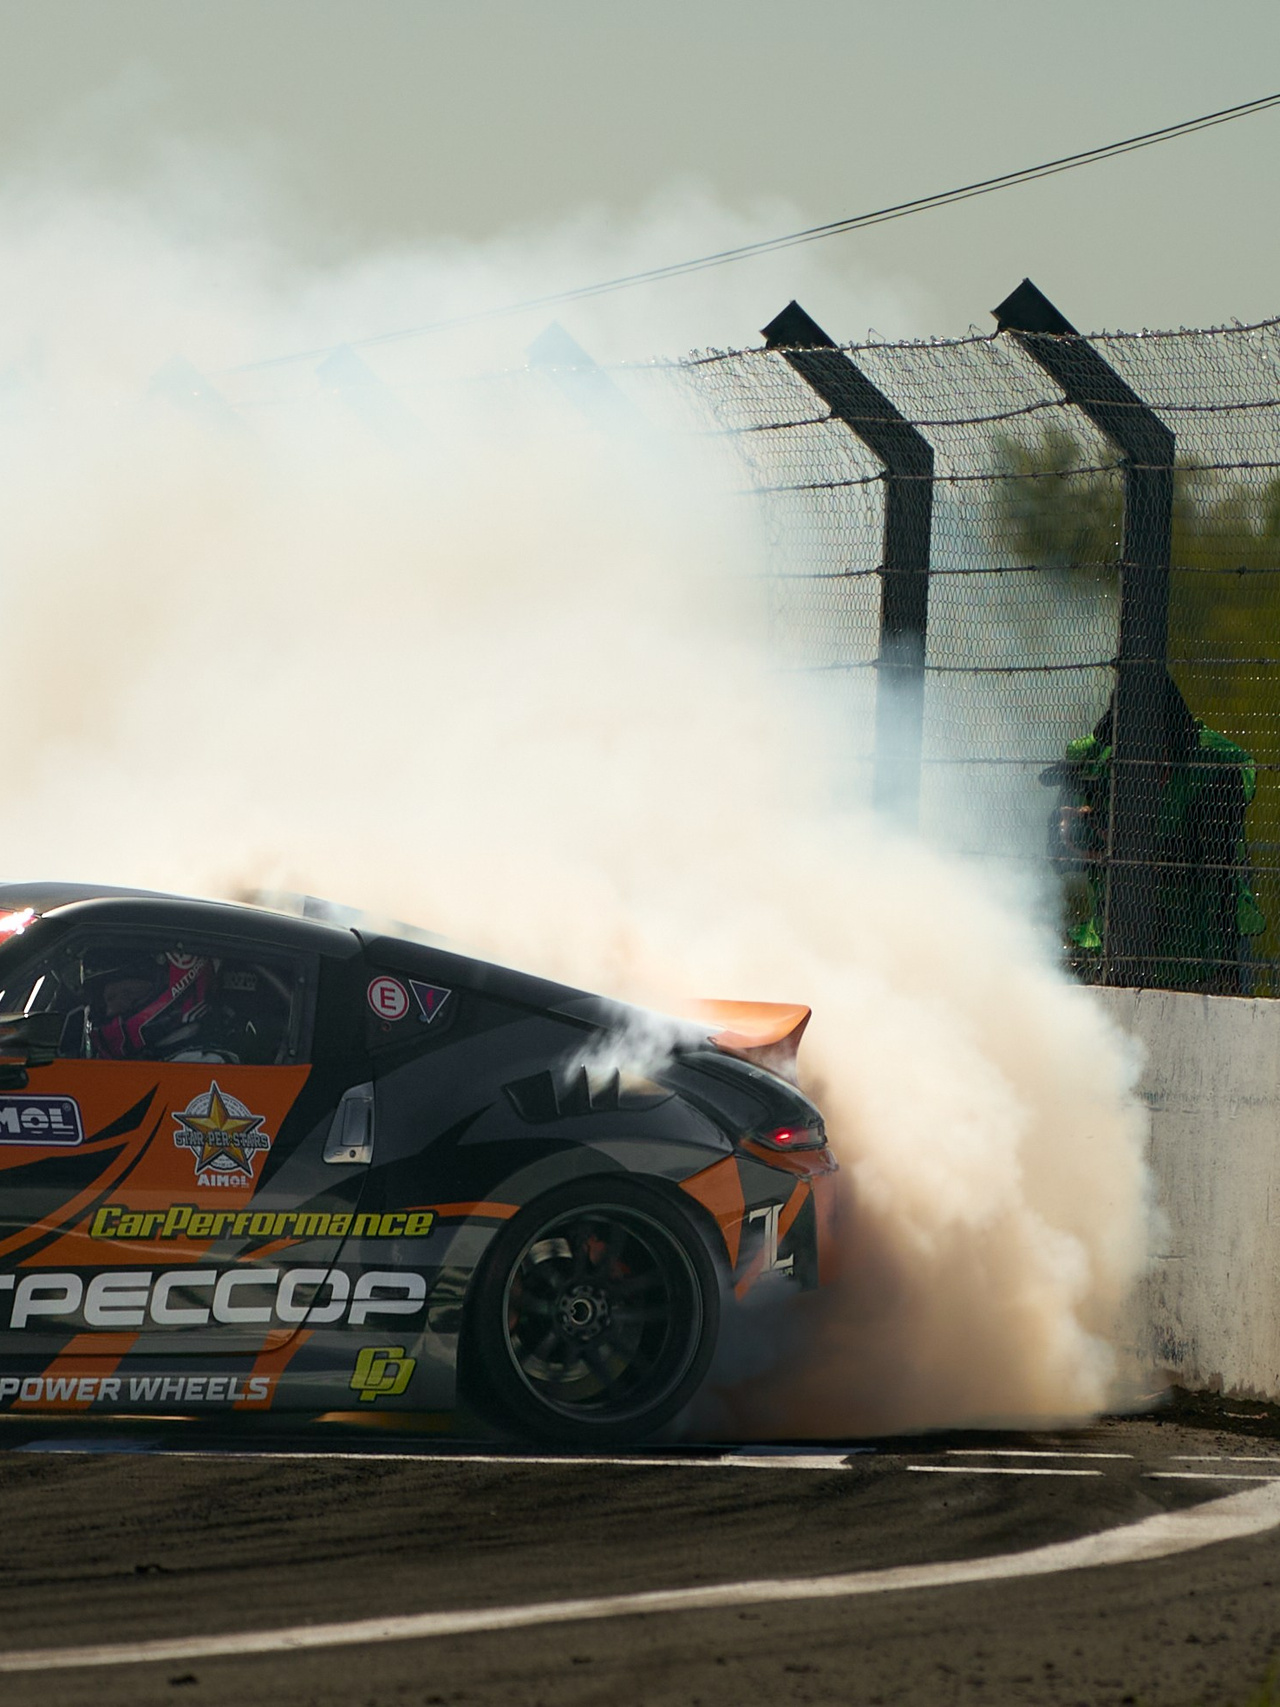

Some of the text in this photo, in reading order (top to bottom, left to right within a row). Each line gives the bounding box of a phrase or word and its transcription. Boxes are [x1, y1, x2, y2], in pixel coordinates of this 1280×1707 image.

[380, 987, 396, 1010] E
[197, 1174, 249, 1187] AIMOL
[90, 1206, 434, 1237] CarPerformance
[129, 1377, 271, 1401] WHEELS
